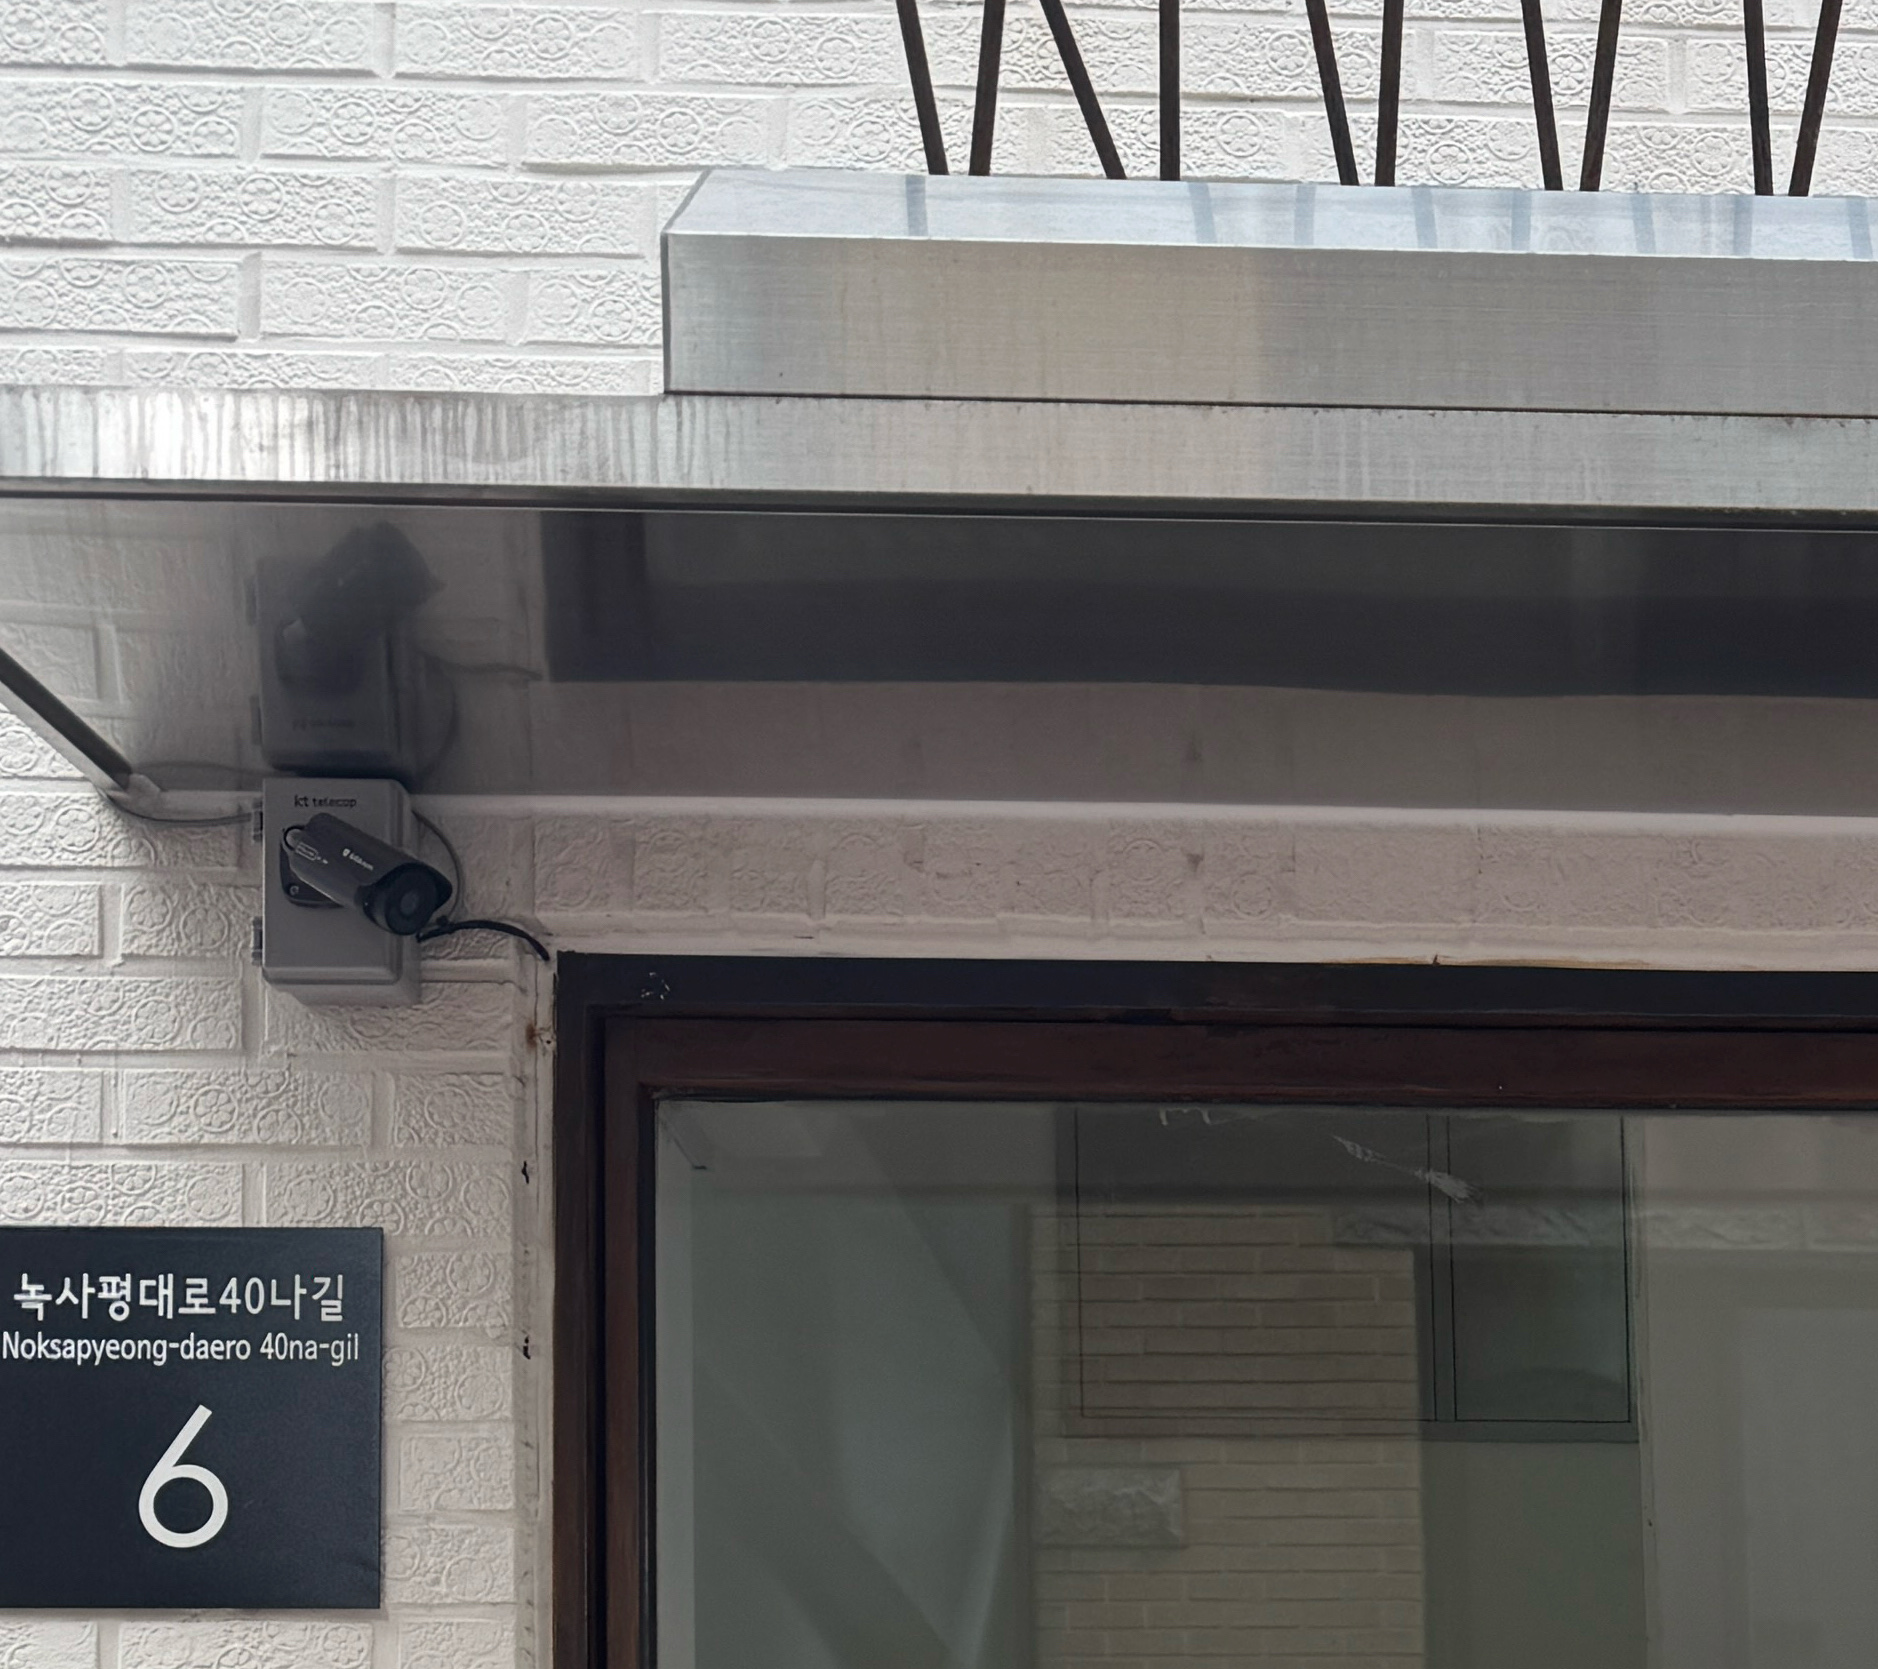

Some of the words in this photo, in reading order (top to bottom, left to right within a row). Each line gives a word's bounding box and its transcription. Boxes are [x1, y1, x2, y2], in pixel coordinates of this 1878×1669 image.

[13, 1272, 344, 1322] 녹사평대로40나길
[2, 1331, 251, 1366] Noksapyeong-daero
[259, 1332, 359, 1367] 40na-gil
[138, 1404, 229, 1548] 6
